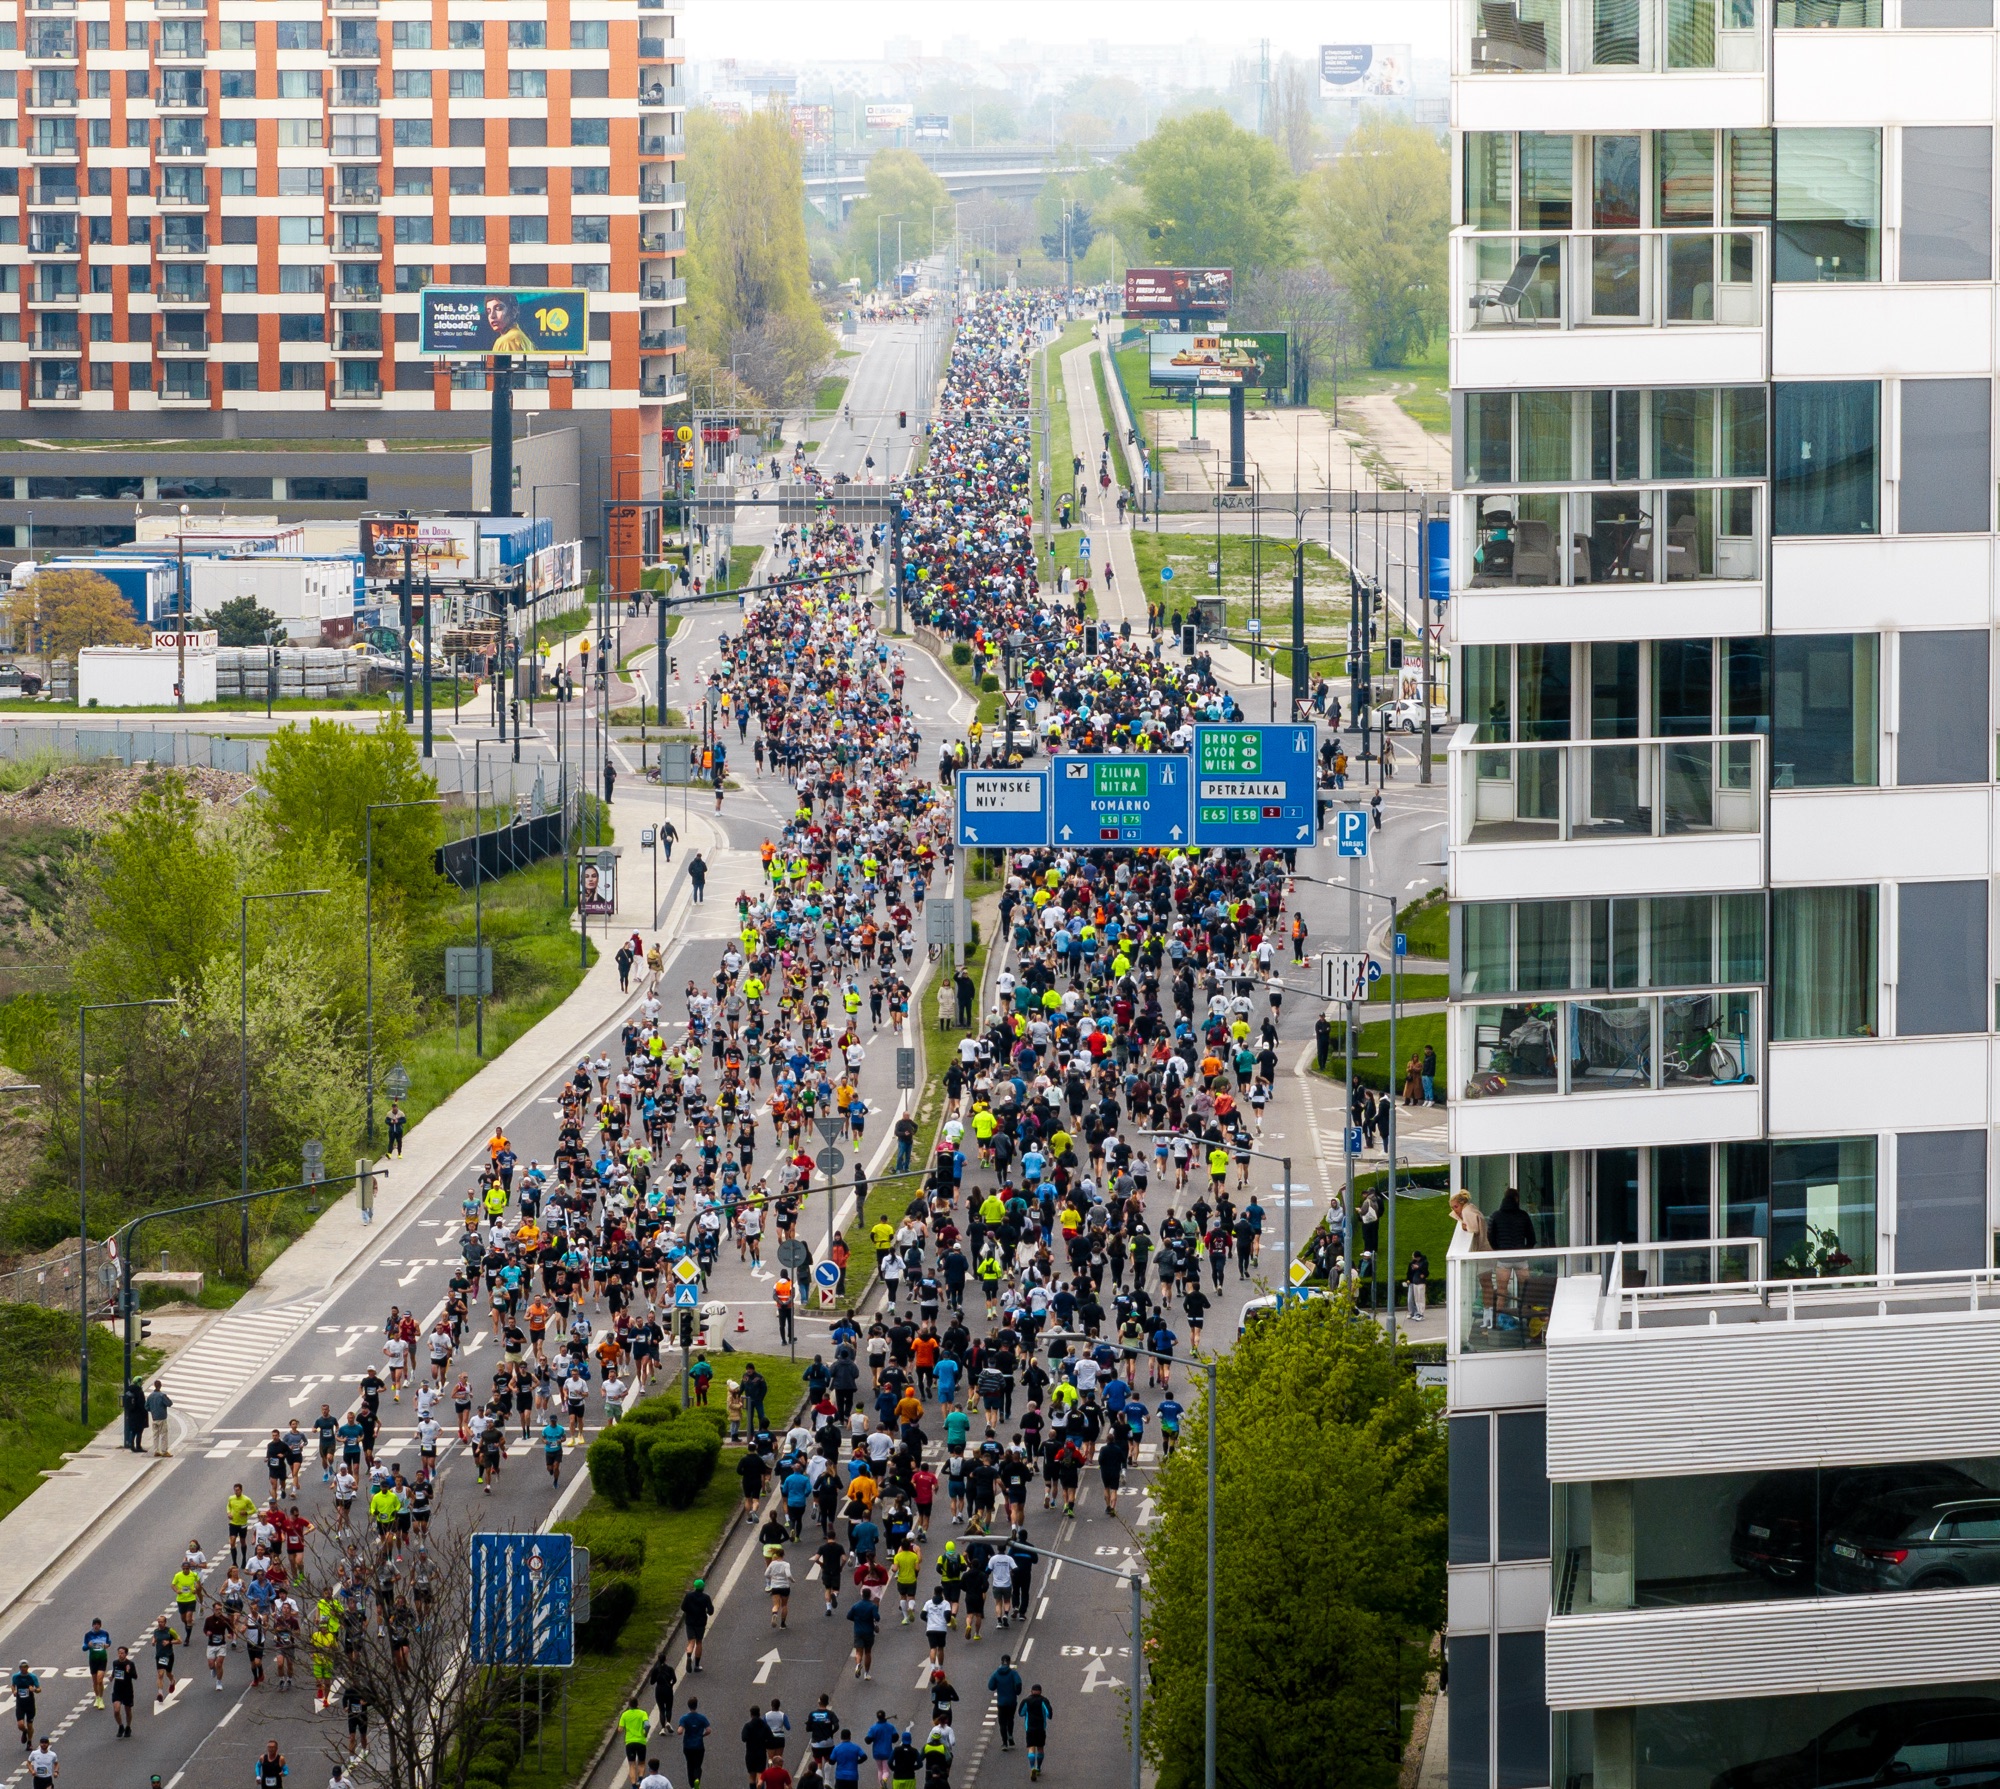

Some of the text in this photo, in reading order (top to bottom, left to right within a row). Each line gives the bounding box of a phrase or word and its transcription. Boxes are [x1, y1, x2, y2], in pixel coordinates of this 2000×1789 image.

[433, 303, 479, 314] Vieš, čo je
[433, 312, 481, 321] nekonečná
[1212, 496, 1245, 509] GAZA
[396, 526, 405, 535] Je
[1204, 734, 1255, 745] BRNO CZ
[1204, 760, 1252, 771] WIEN A
[1101, 765, 1141, 778] ŽILINA
[976, 780, 1031, 793] MLYNSKÉ
[1100, 781, 1138, 792] NITRA
[1208, 782, 1280, 795] PETRŽALKA
[1090, 797, 1151, 811] KOMÁRNO
[1291, 808, 1296, 816] 2
[1345, 814, 1361, 840] P
[1126, 830, 1137, 838] 63
[1341, 840, 1364, 848] VERSUS
[1397, 936, 1403, 949] P
[315, 1325, 379, 1334] US
[1094, 1545, 1147, 1557] BU
[1060, 1645, 1133, 1658] BUS
